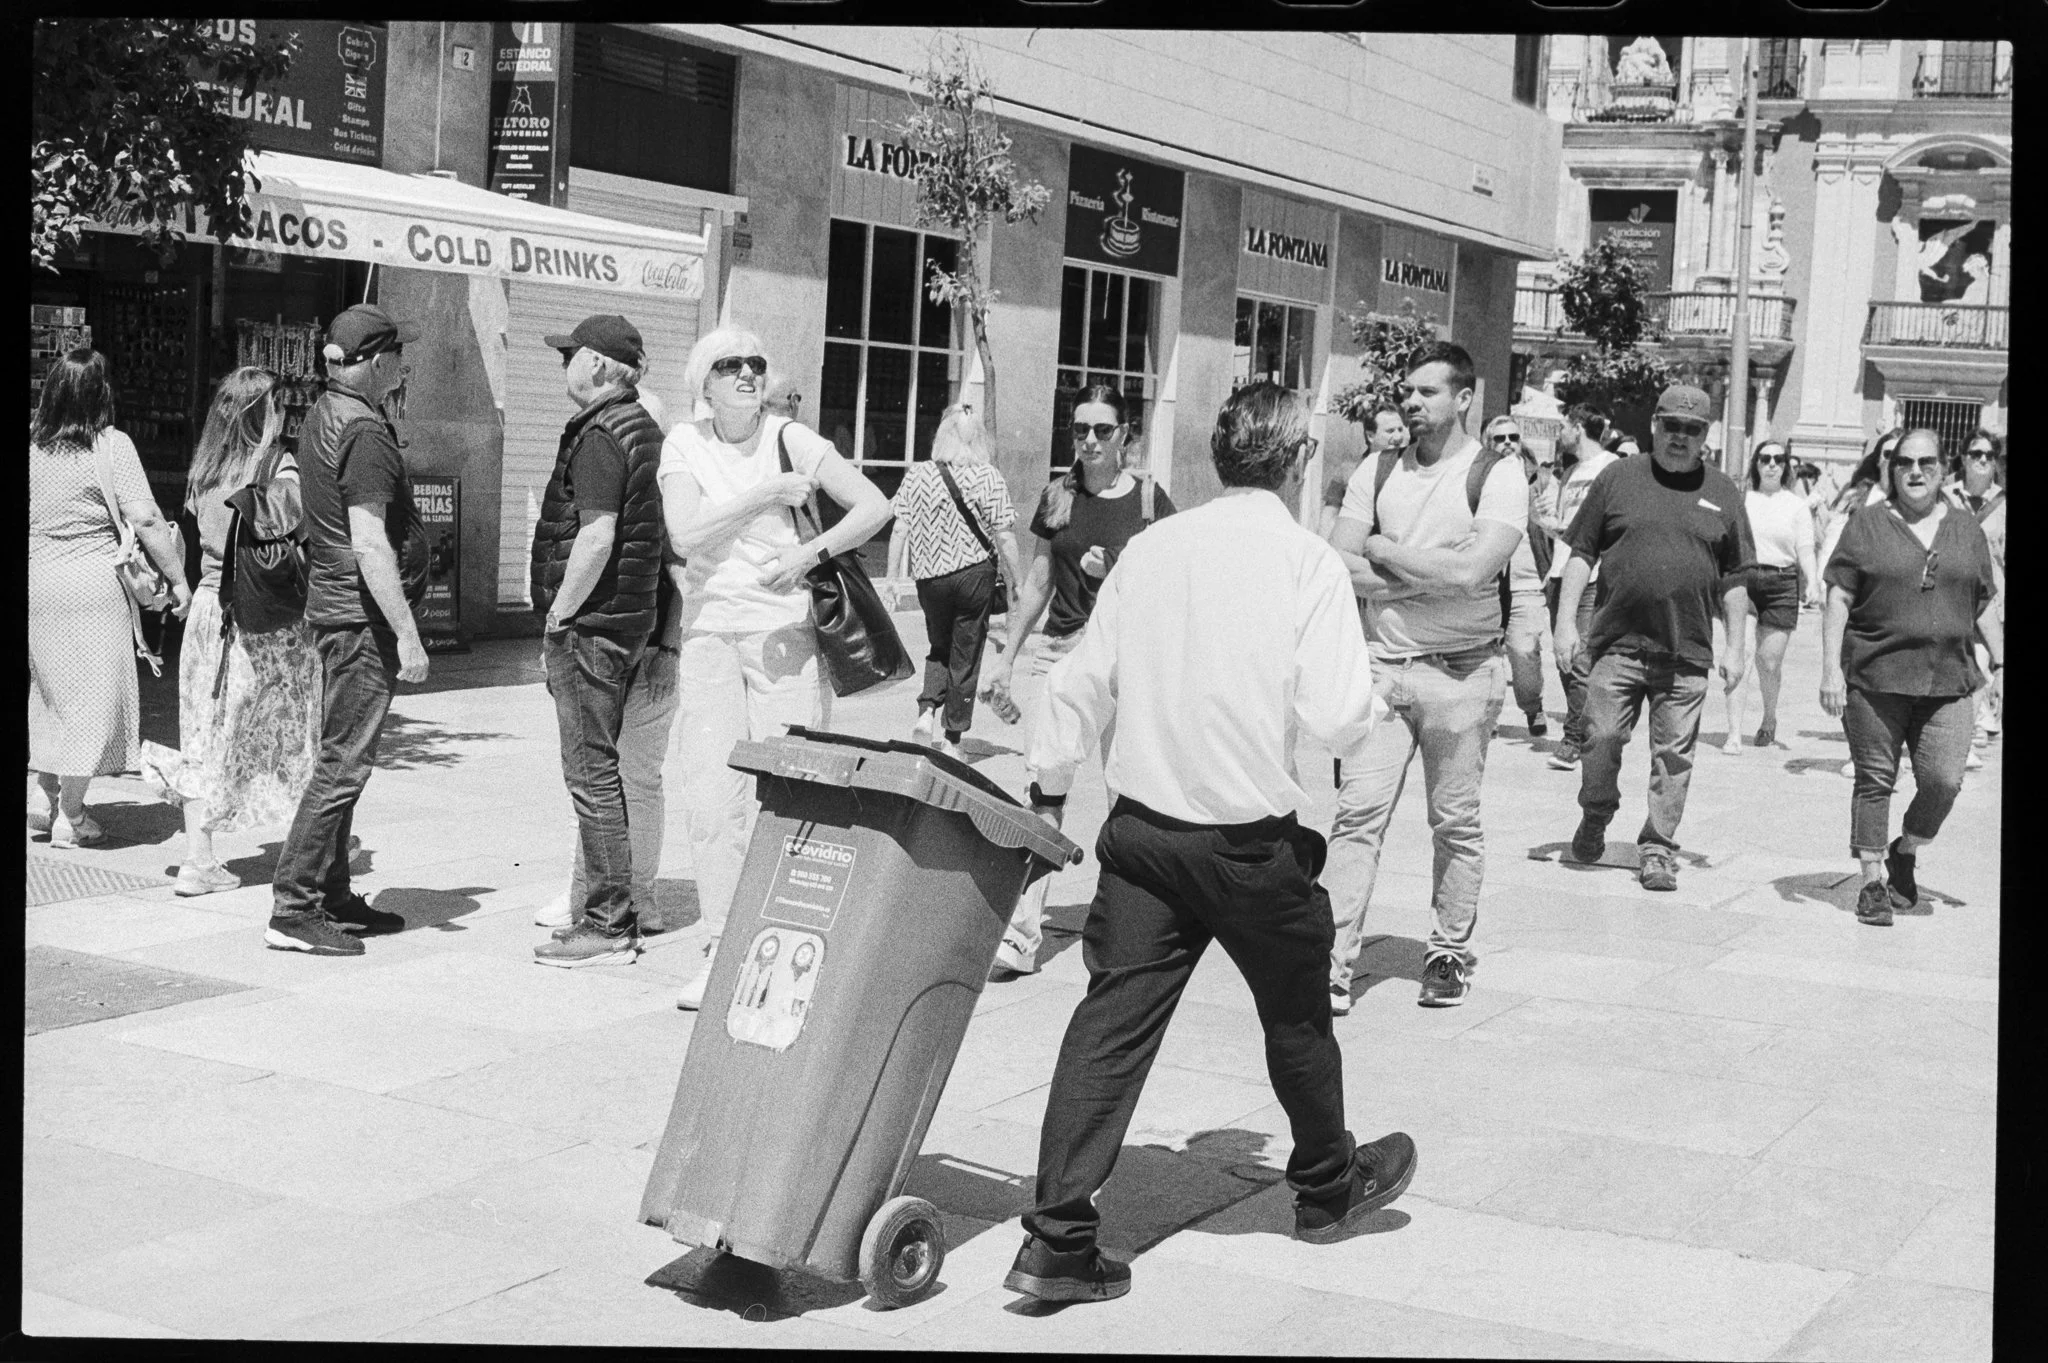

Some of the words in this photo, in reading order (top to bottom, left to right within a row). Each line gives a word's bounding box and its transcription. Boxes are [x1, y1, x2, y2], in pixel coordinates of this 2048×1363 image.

[463, 51, 470, 66] 2
[500, 47, 551, 59] ESTANCO
[496, 60, 553, 72] CATEDRAL
[347, 101, 366, 113] Gifts
[342, 113, 370, 127] Stamps
[333, 127, 348, 138] Bus
[333, 142, 351, 153] Cold
[847, 135, 876, 171] LA
[1247, 227, 1266, 255] LA
[1268, 231, 1328, 268] FONTANA
[1385, 260, 1399, 282] LA
[1401, 262, 1449, 293] FONTANA
[413, 484, 453, 496] BEBIDAS
[432, 514, 454, 522] LLEVAR
[785, 842, 853, 863] ecovidrio
